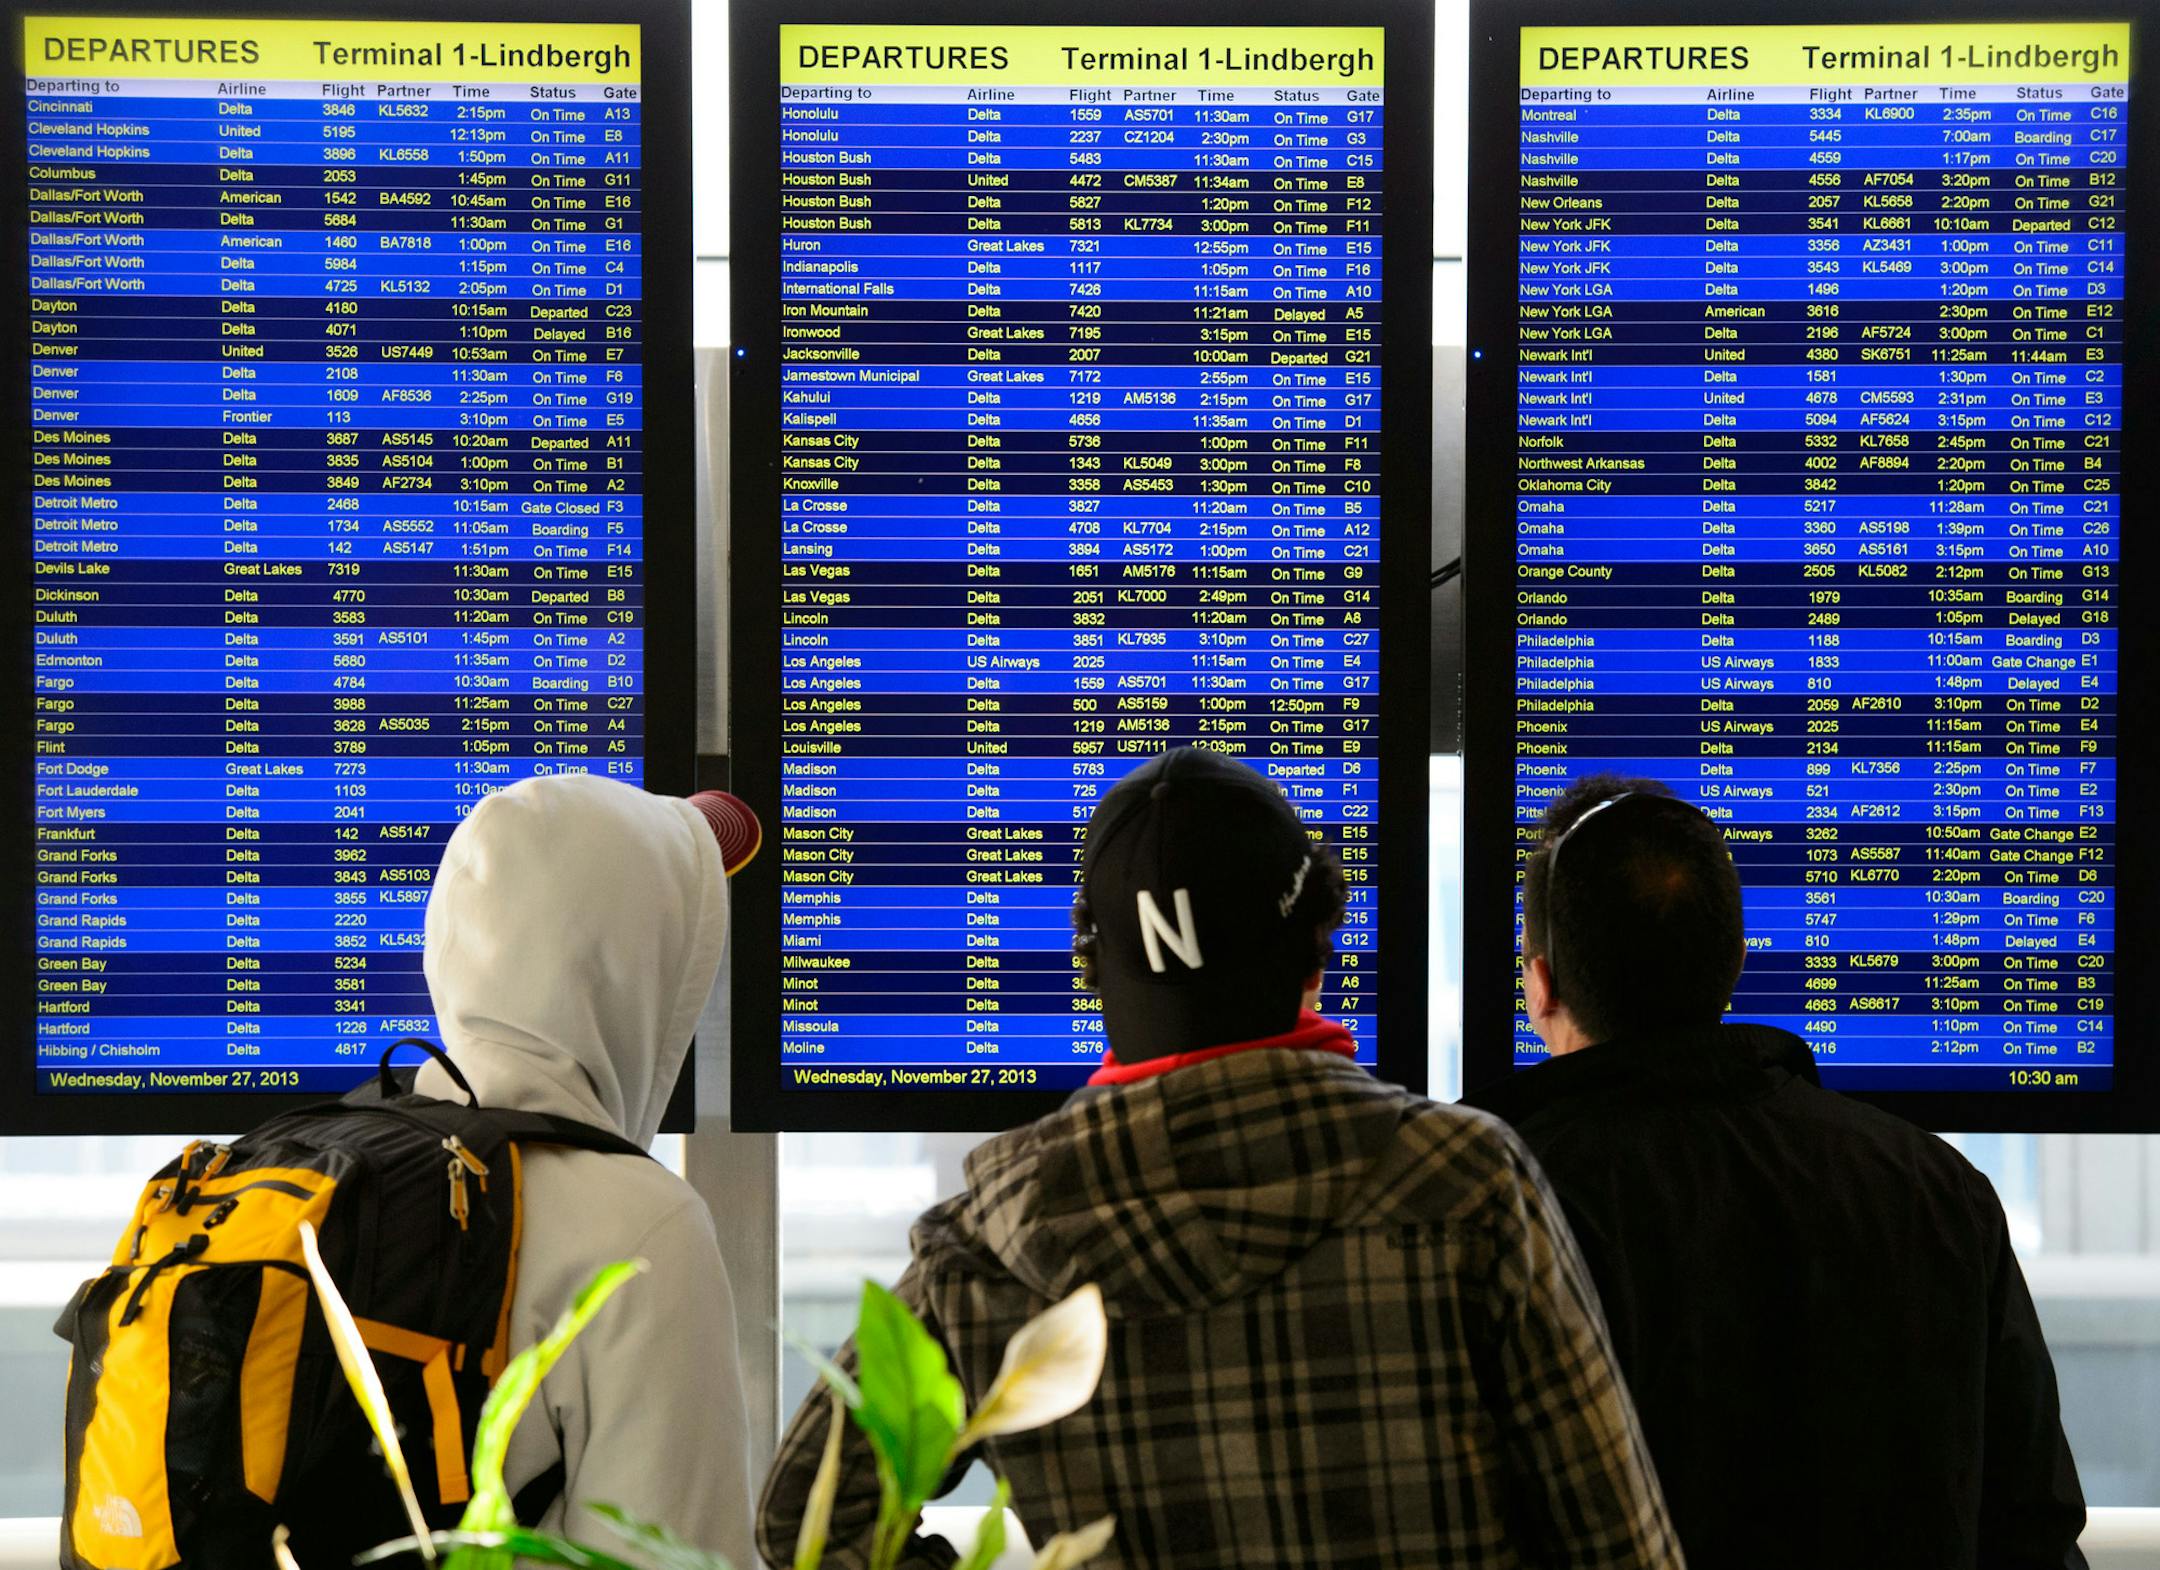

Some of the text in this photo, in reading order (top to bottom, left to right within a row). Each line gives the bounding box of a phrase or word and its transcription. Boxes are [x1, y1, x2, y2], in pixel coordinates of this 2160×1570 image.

[44, 36, 632, 75] DEPARTURES Terminal 1-Lindbergh
[799, 45, 1374, 78] DEPARTURES Terminal 1-Lindbergh
[1539, 43, 2119, 74] DEPARTURES Terminal 1-Lindbergh
[25, 78, 637, 99] Departing to Airline Flight Partner Time Status Gate
[778, 83, 1380, 104] Departing to Airline Flight Partner Time Status Gate
[1517, 85, 2125, 105] Departing to Airline Flight Partner Time Status Gate
[27, 99, 631, 122] Cincinnati Delta 3846 KL5632 2:15pm On Time A13
[1521, 106, 2118, 123] Montreal Delta 3334 KL6900 2:35pm On Time C16
[782, 128, 1367, 148] Honolulu Delta 2237 CZ1204 2:30pm On Time G3
[32, 342, 624, 363] Denver United 3526 US7449 10:53am On Time E7
[782, 347, 1371, 367] Jacksonville Delta 2007 10:00am Departed G21
[1519, 348, 1568, 362] Newark
[1704, 348, 1746, 361] United
[1806, 347, 1839, 361] 4380
[1860, 347, 1911, 361] SK6751
[1931, 348, 1987, 362] 11:25am
[2011, 350, 2067, 363] 11:44am
[2085, 347, 2105, 361] E3
[1518, 456, 2102, 473] Northwest Arkansas Delta 4002 AF8894 2:20pm On Time B4
[34, 495, 624, 515] Detroit Metro Delta 2468 10:15am Gate Closed F3
[783, 542, 1369, 560] Lansing Delta 3894 AS5172 1:00pm On Time C21
[1517, 653, 2098, 671] Philadelphia US Airways 1833 11:00am Gate Change E1
[783, 696, 1360, 715] Los Angeles Delta 500 AS5159 1:00pm 12:50pm F9
[36, 717, 626, 734] Fargo Delta 3628 AS5035 2:15pm On Time A4
[1137, 888, 1203, 973] N
[1804, 954, 2105, 970] 3333 KL5679 3:00pm On Time C20
[38, 1042, 367, 1059] Hibbing / Chisholm Delta 4817
[783, 1041, 1104, 1054] Moline Delta 3576
[50, 1071, 300, 1090] Wednesday, November 27, 2013
[793, 1069, 1037, 1087] Wednesday, November 27, 2013
[2009, 1070, 2079, 1085] 10:30 am
